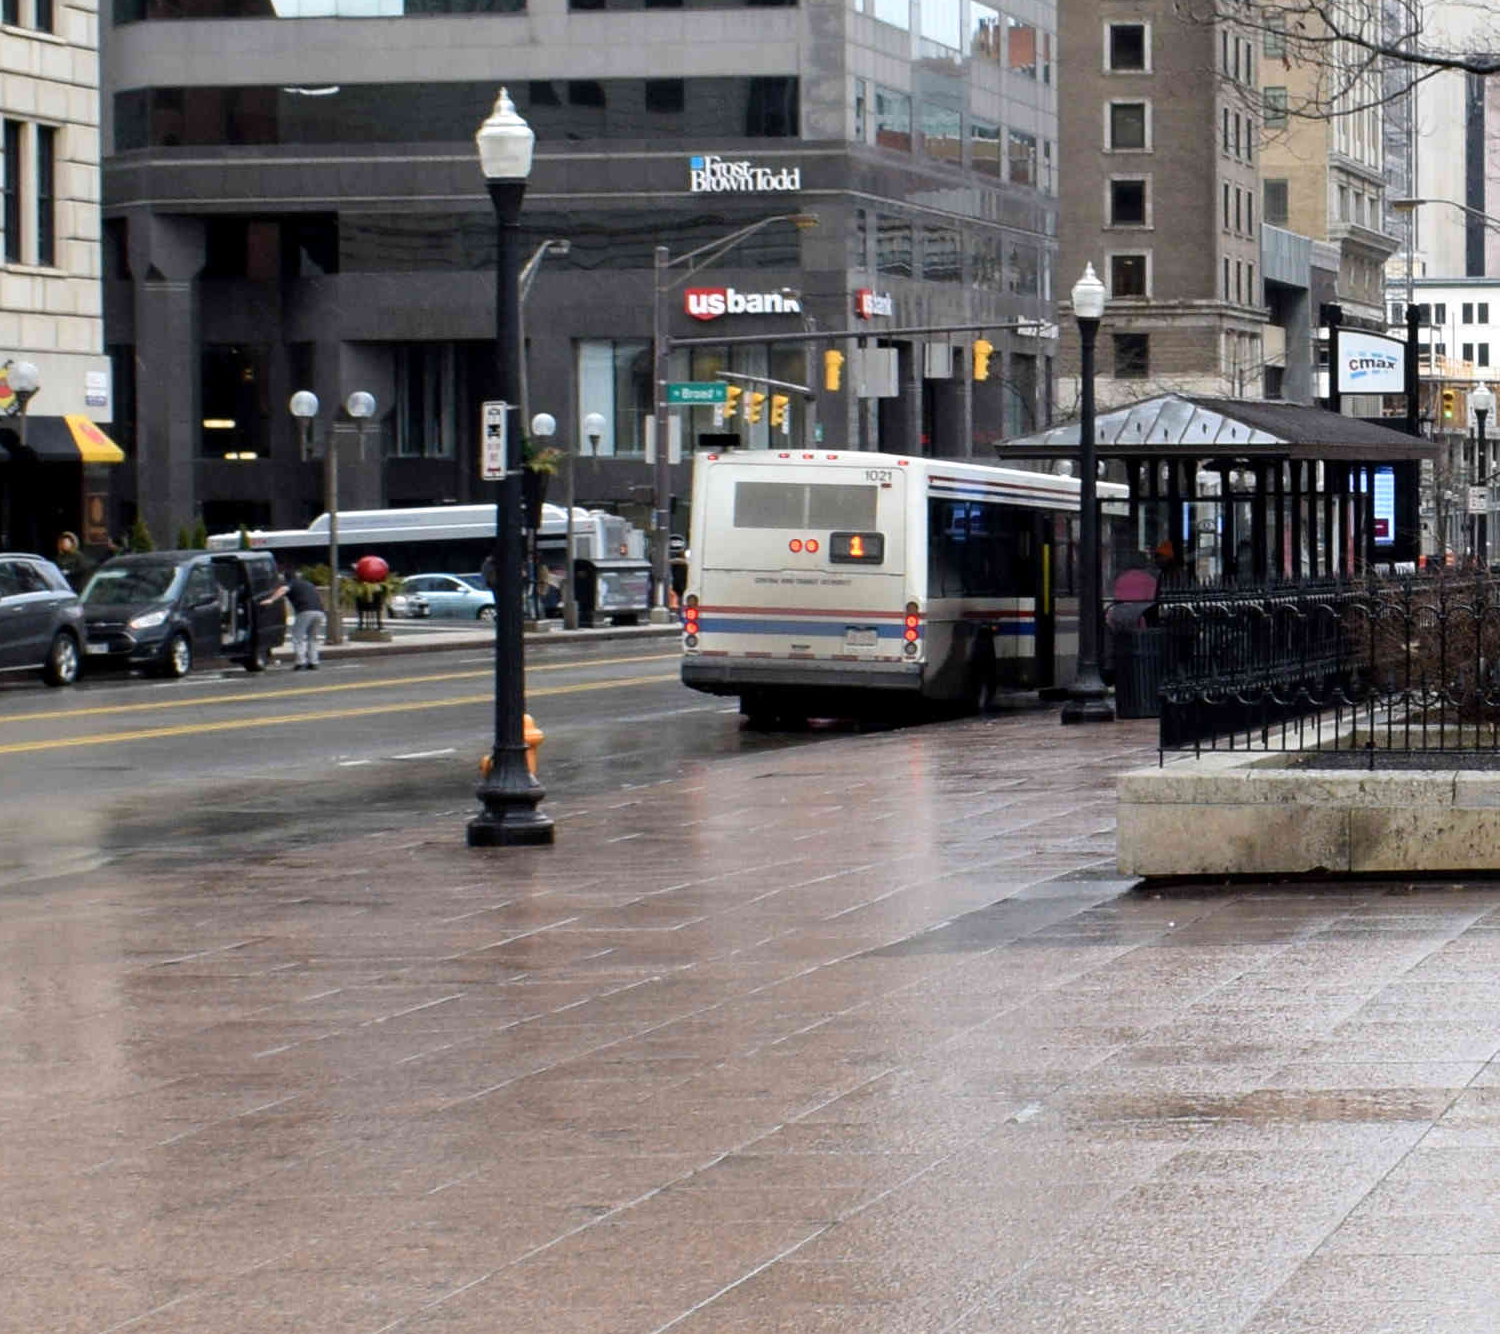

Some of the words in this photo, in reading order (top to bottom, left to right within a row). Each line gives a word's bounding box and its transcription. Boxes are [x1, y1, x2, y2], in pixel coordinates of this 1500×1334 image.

[704, 155, 752, 179] Frost
[691, 169, 753, 192] Brown
[750, 168, 800, 191] Todd
[1348, 358, 1396, 372] cmax
[681, 388, 714, 399] Broad
[850, 536, 864, 557] 1
